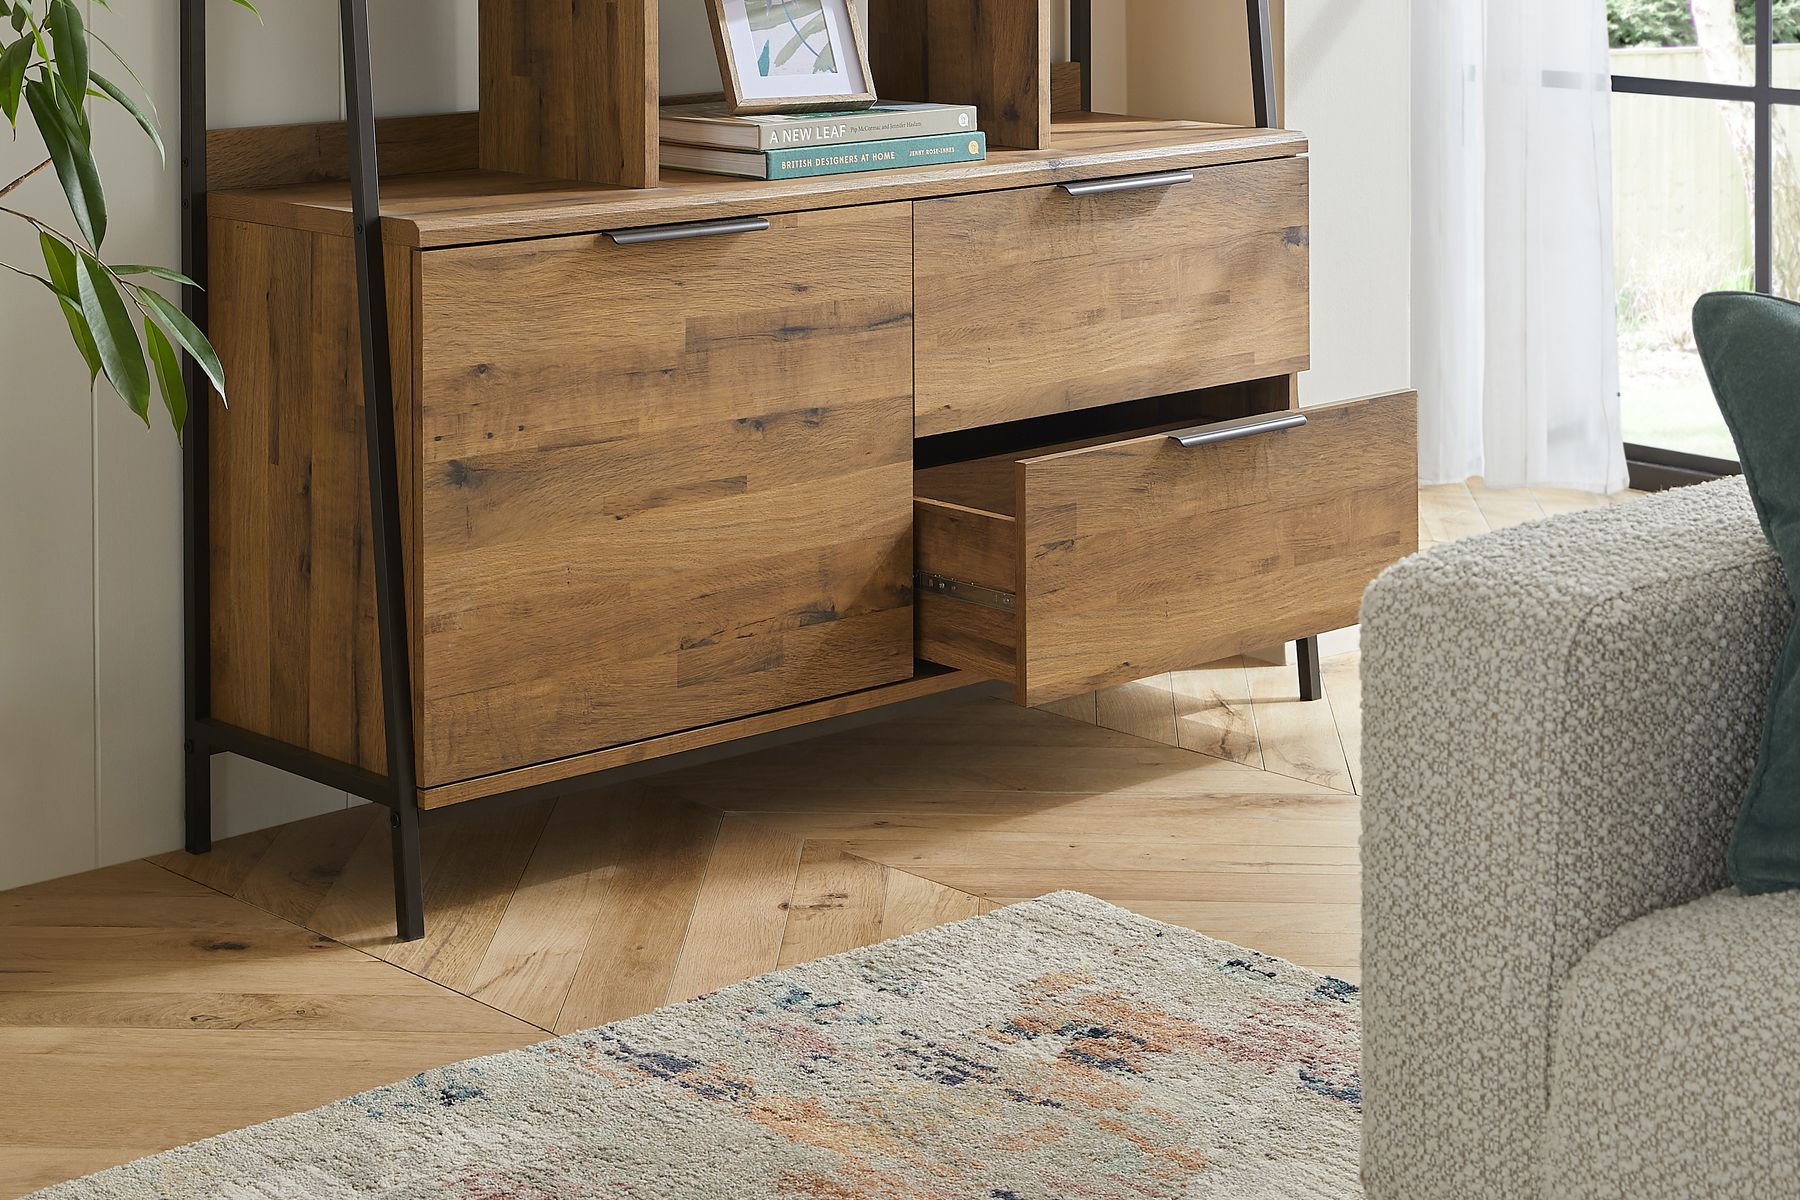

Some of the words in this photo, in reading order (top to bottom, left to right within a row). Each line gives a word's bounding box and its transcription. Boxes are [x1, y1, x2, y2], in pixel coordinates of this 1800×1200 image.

[769, 131, 779, 144] A
[783, 127, 812, 142] NEW
[816, 125, 846, 140] LEAF
[850, 126, 858, 134] Pip
[909, 149, 924, 157] JENNY
[781, 159, 812, 170] BRITISH
[816, 154, 858, 167] DESIGNERS
[861, 153, 869, 162] AT
[872, 151, 895, 161] HOME
